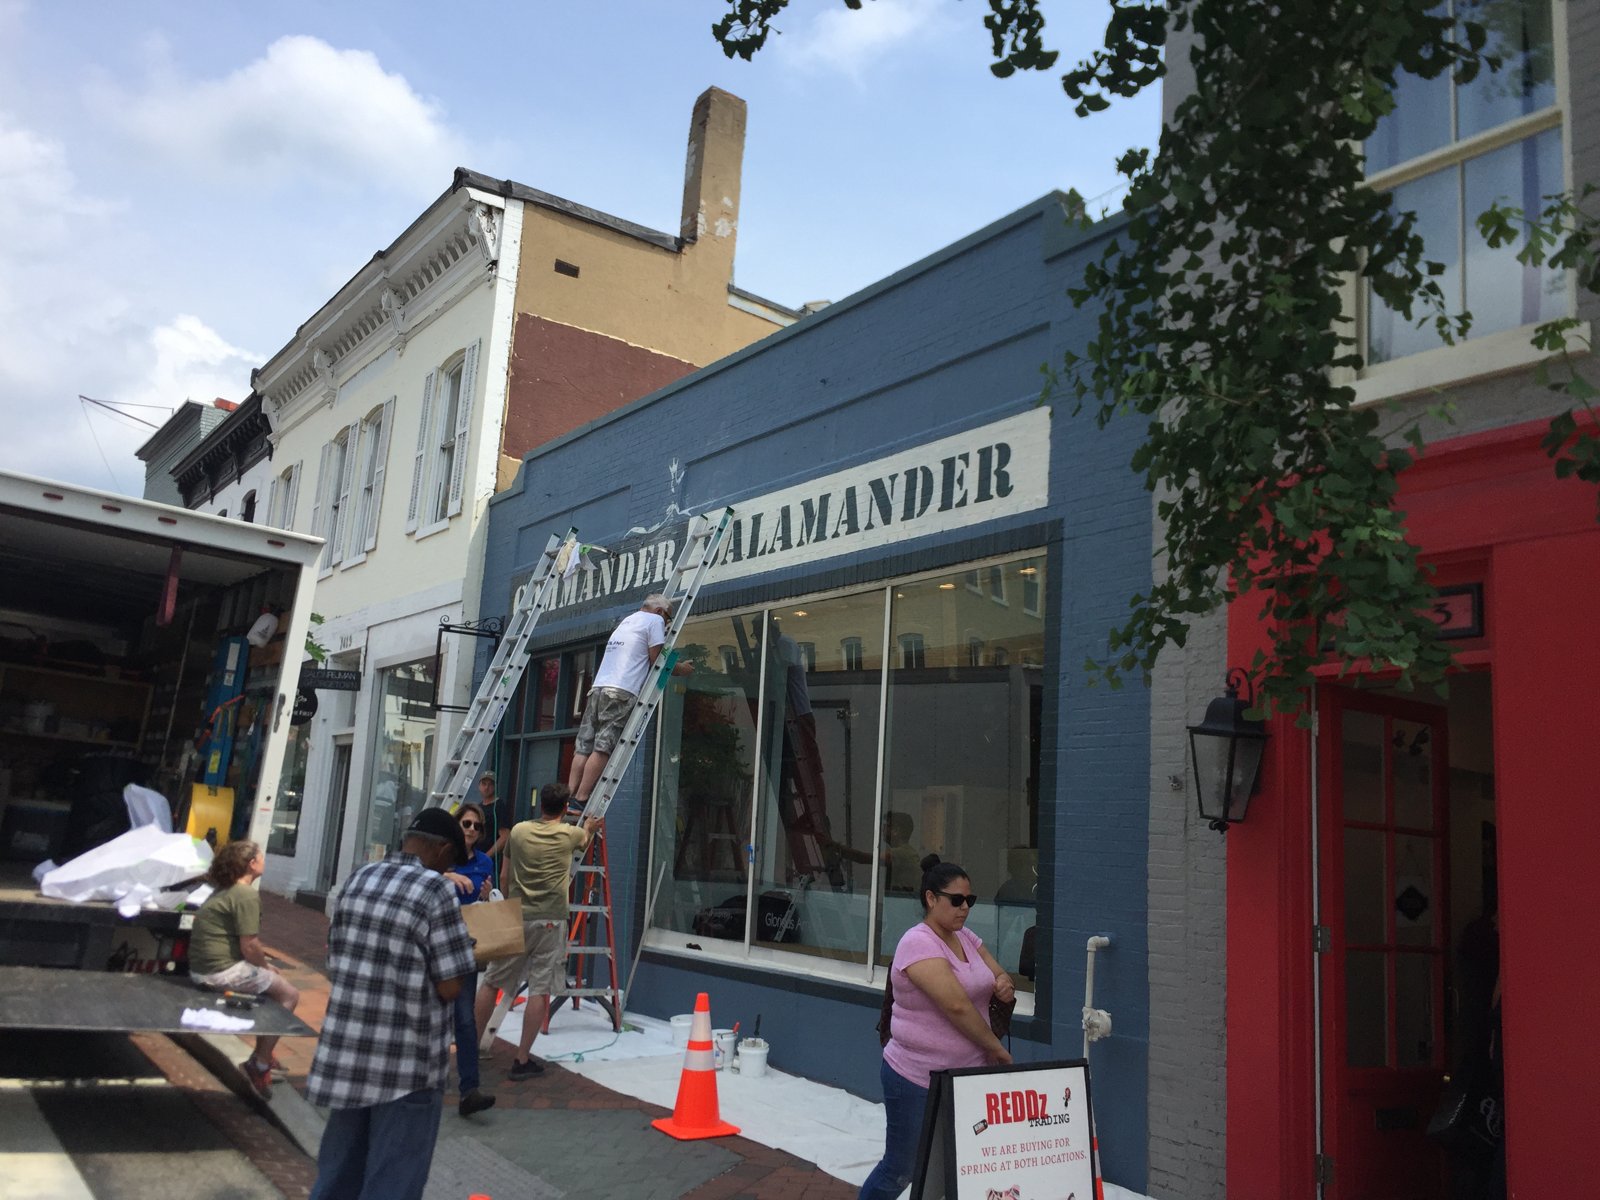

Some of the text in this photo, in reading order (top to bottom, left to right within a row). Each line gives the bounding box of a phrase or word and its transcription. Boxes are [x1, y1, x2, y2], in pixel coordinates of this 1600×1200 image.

[703, 442, 1014, 569] SALAMANDER
[1028, 1113, 1070, 1128] TRADING
[981, 1137, 1070, 1158] WE ARE BUYING FOR
[960, 1150, 1087, 1176] SPRING AT BOTH LOCATIONS.
